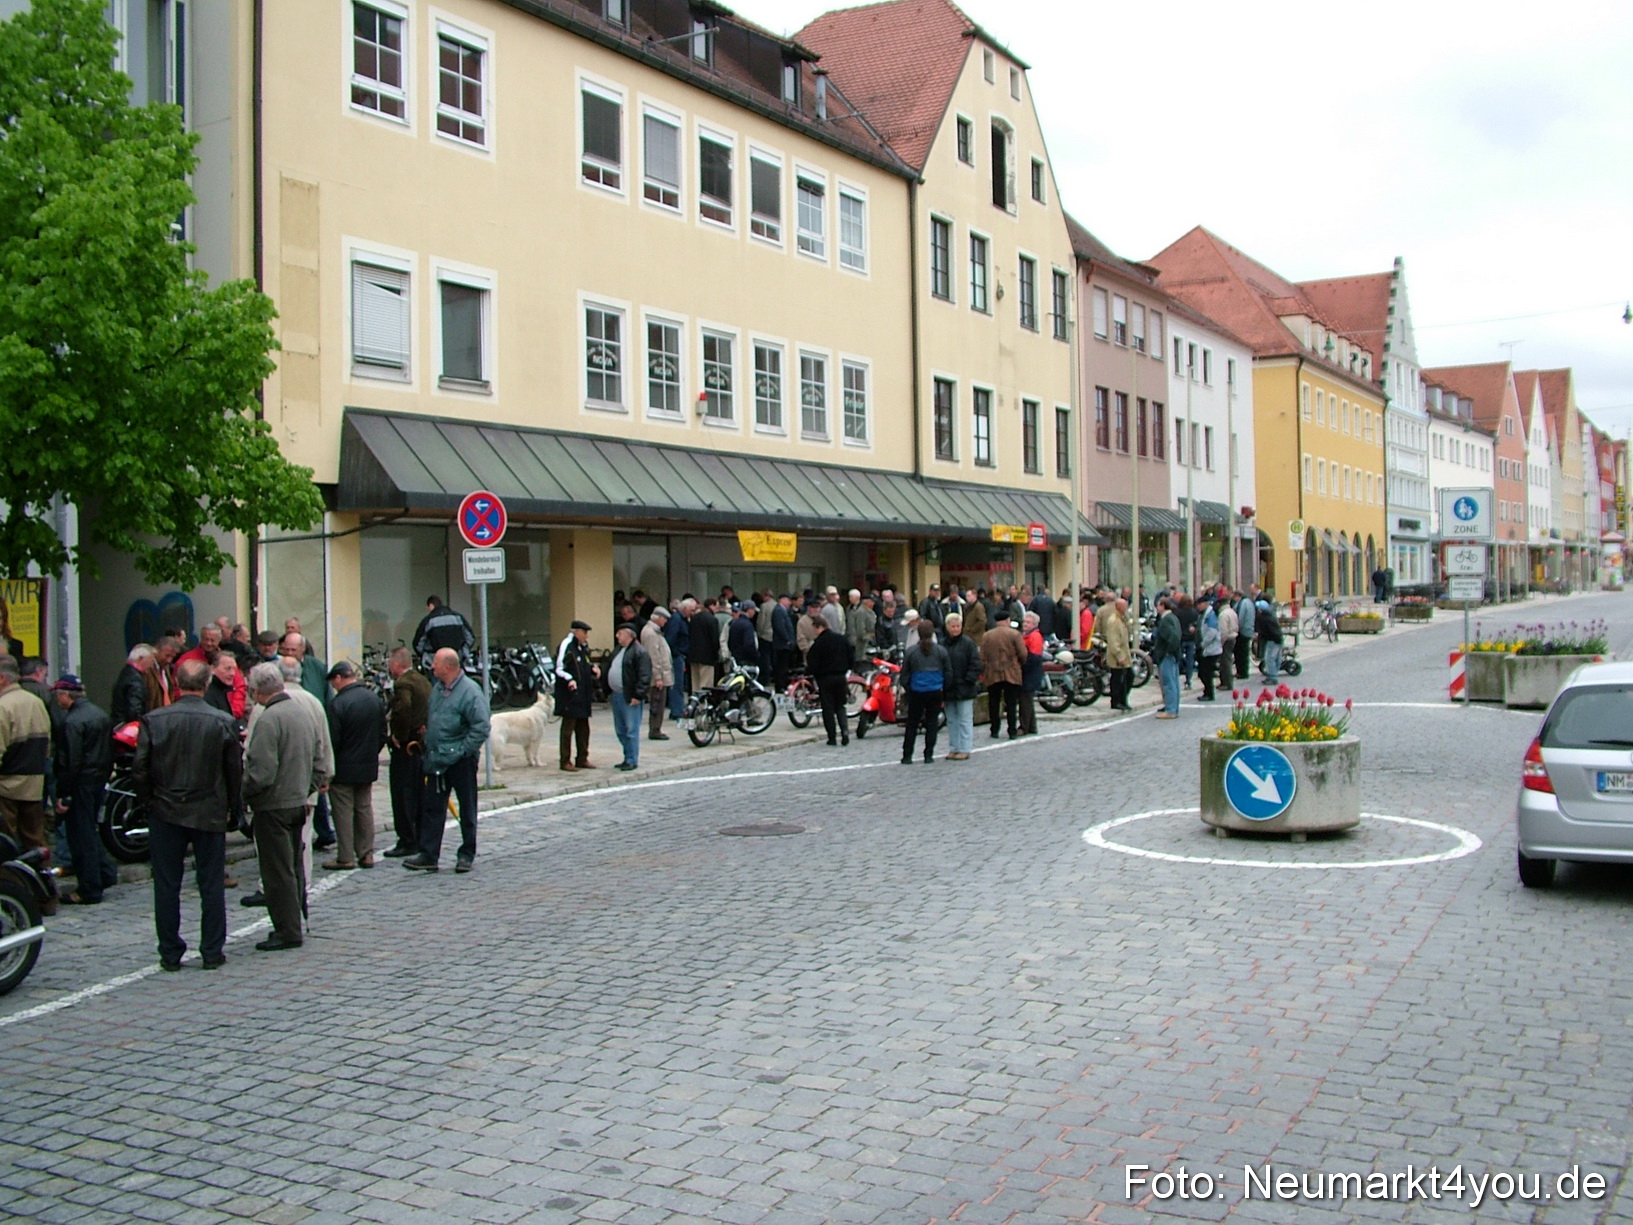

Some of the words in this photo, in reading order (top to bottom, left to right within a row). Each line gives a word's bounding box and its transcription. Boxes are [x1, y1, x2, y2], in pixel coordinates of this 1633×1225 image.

[1454, 525, 1479, 534] ZONE
[0, 580, 40, 605] WIR
[1607, 774, 1625, 788] NM
